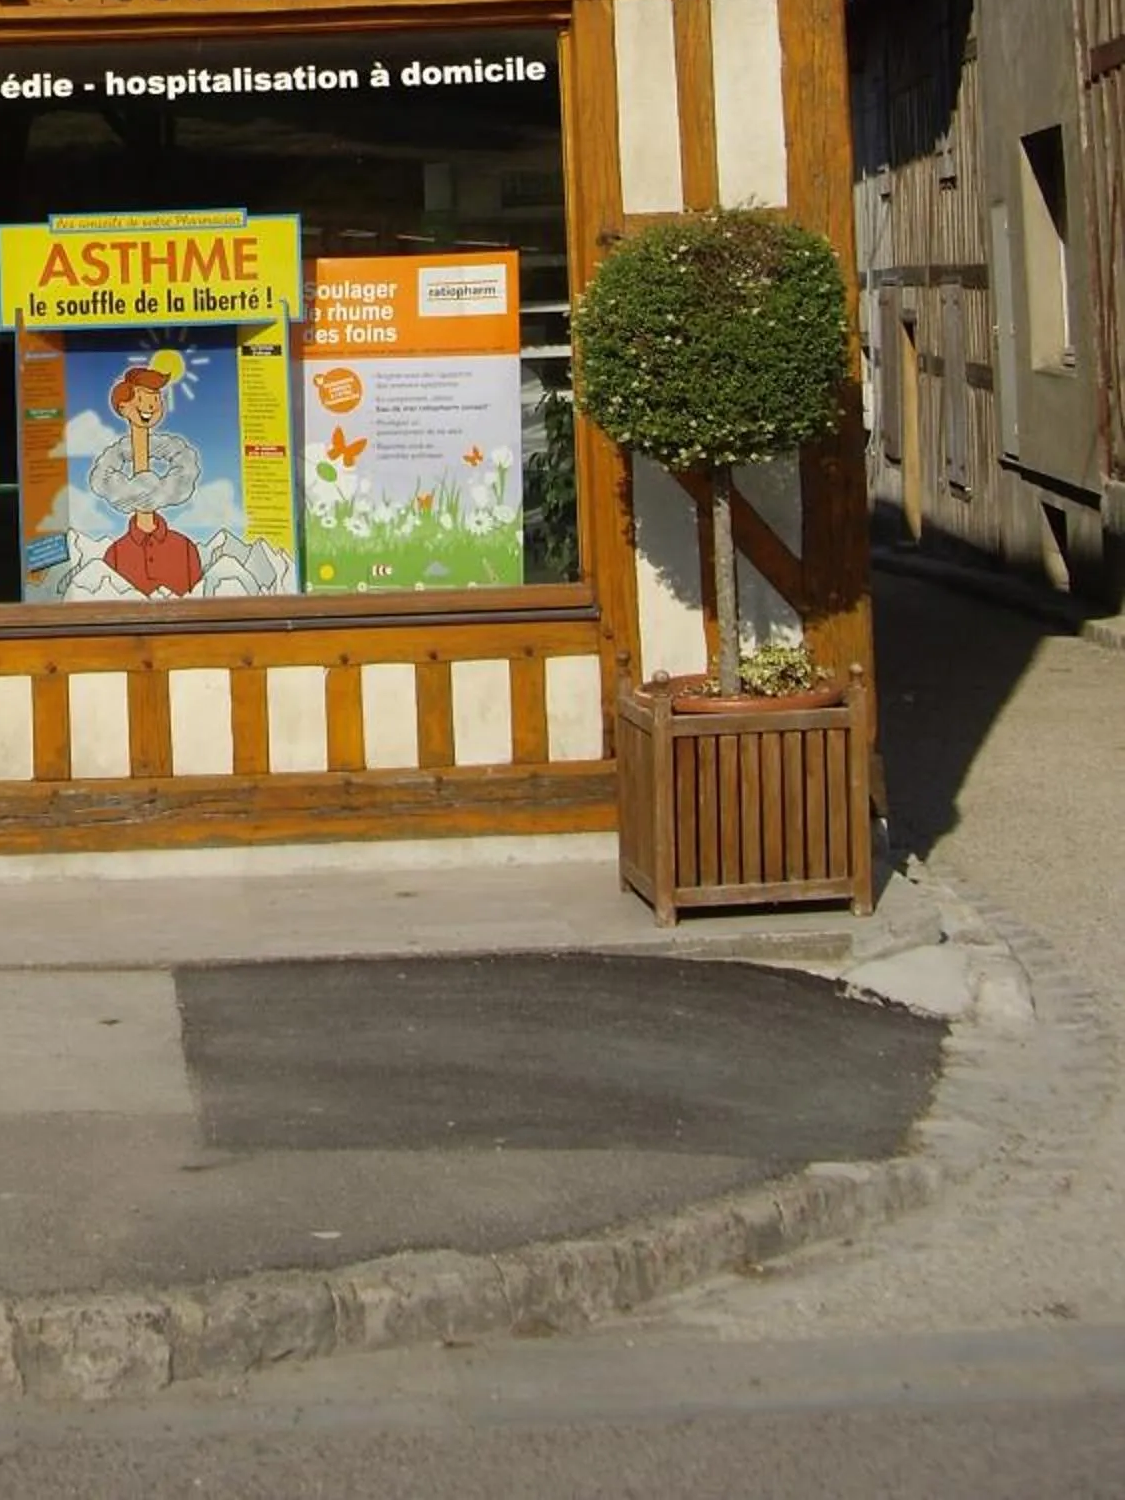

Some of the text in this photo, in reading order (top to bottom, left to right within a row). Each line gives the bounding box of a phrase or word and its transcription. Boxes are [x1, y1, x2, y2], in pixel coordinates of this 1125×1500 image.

[105, 64, 358, 99] hospitalisation
[369, 60, 390, 87] à
[401, 57, 547, 86] domicile
[38, 238, 258, 287] ASTHME
[29, 293, 46, 316] le
[56, 290, 125, 316] souffle
[135, 289, 158, 313] de
[166, 288, 185, 312] la
[193, 286, 260, 312] liberté
[304, 279, 397, 302] Soulager
[428, 285, 497, 299] ratiopharm
[327, 302, 394, 322] rhume
[303, 324, 398, 344] des foins
